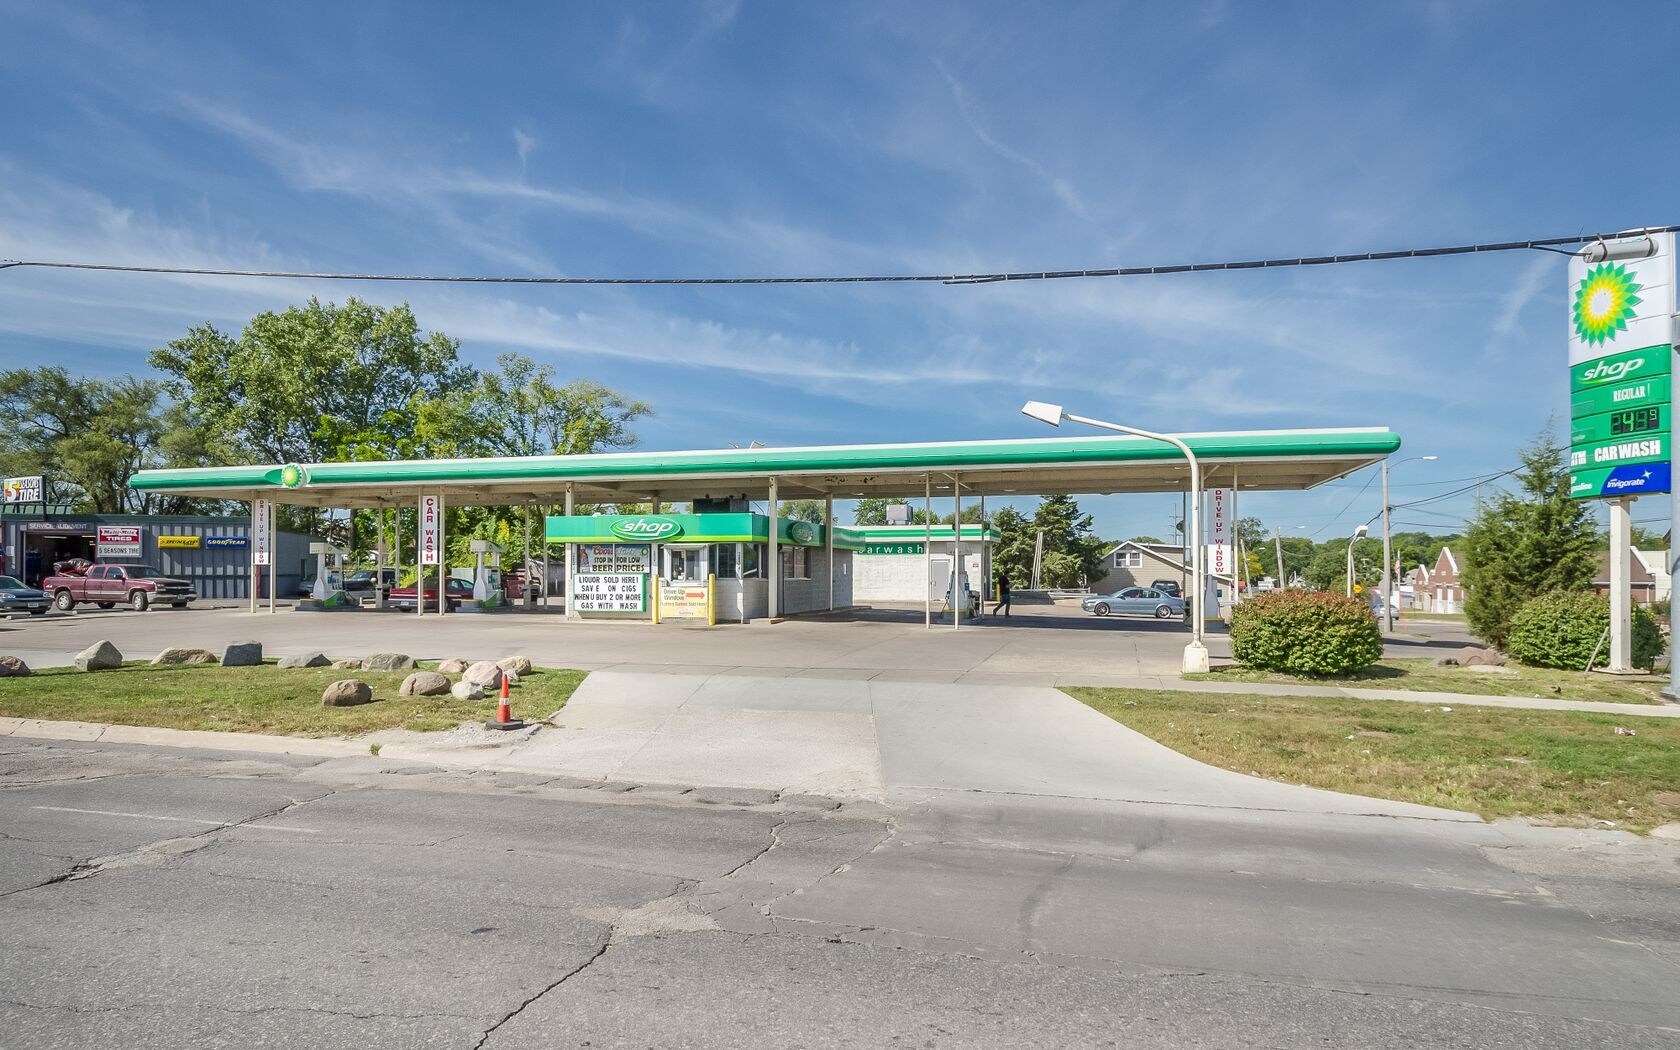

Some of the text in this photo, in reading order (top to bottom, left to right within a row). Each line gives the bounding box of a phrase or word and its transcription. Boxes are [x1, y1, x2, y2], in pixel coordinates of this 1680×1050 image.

[1584, 358, 1645, 380] shop
[1613, 387, 1646, 402] REGULAR
[1594, 445, 1618, 462] CAR
[1618, 439, 1661, 459] WASH
[19, 488, 40, 501] TIRE
[425, 498, 434, 561] CAR WASH
[624, 519, 673, 536] shop
[1215, 489, 1223, 572] DRIVE-UP WINDOW
[207, 538, 246, 546] GOODYEAR
[619, 602, 638, 610] WASH
